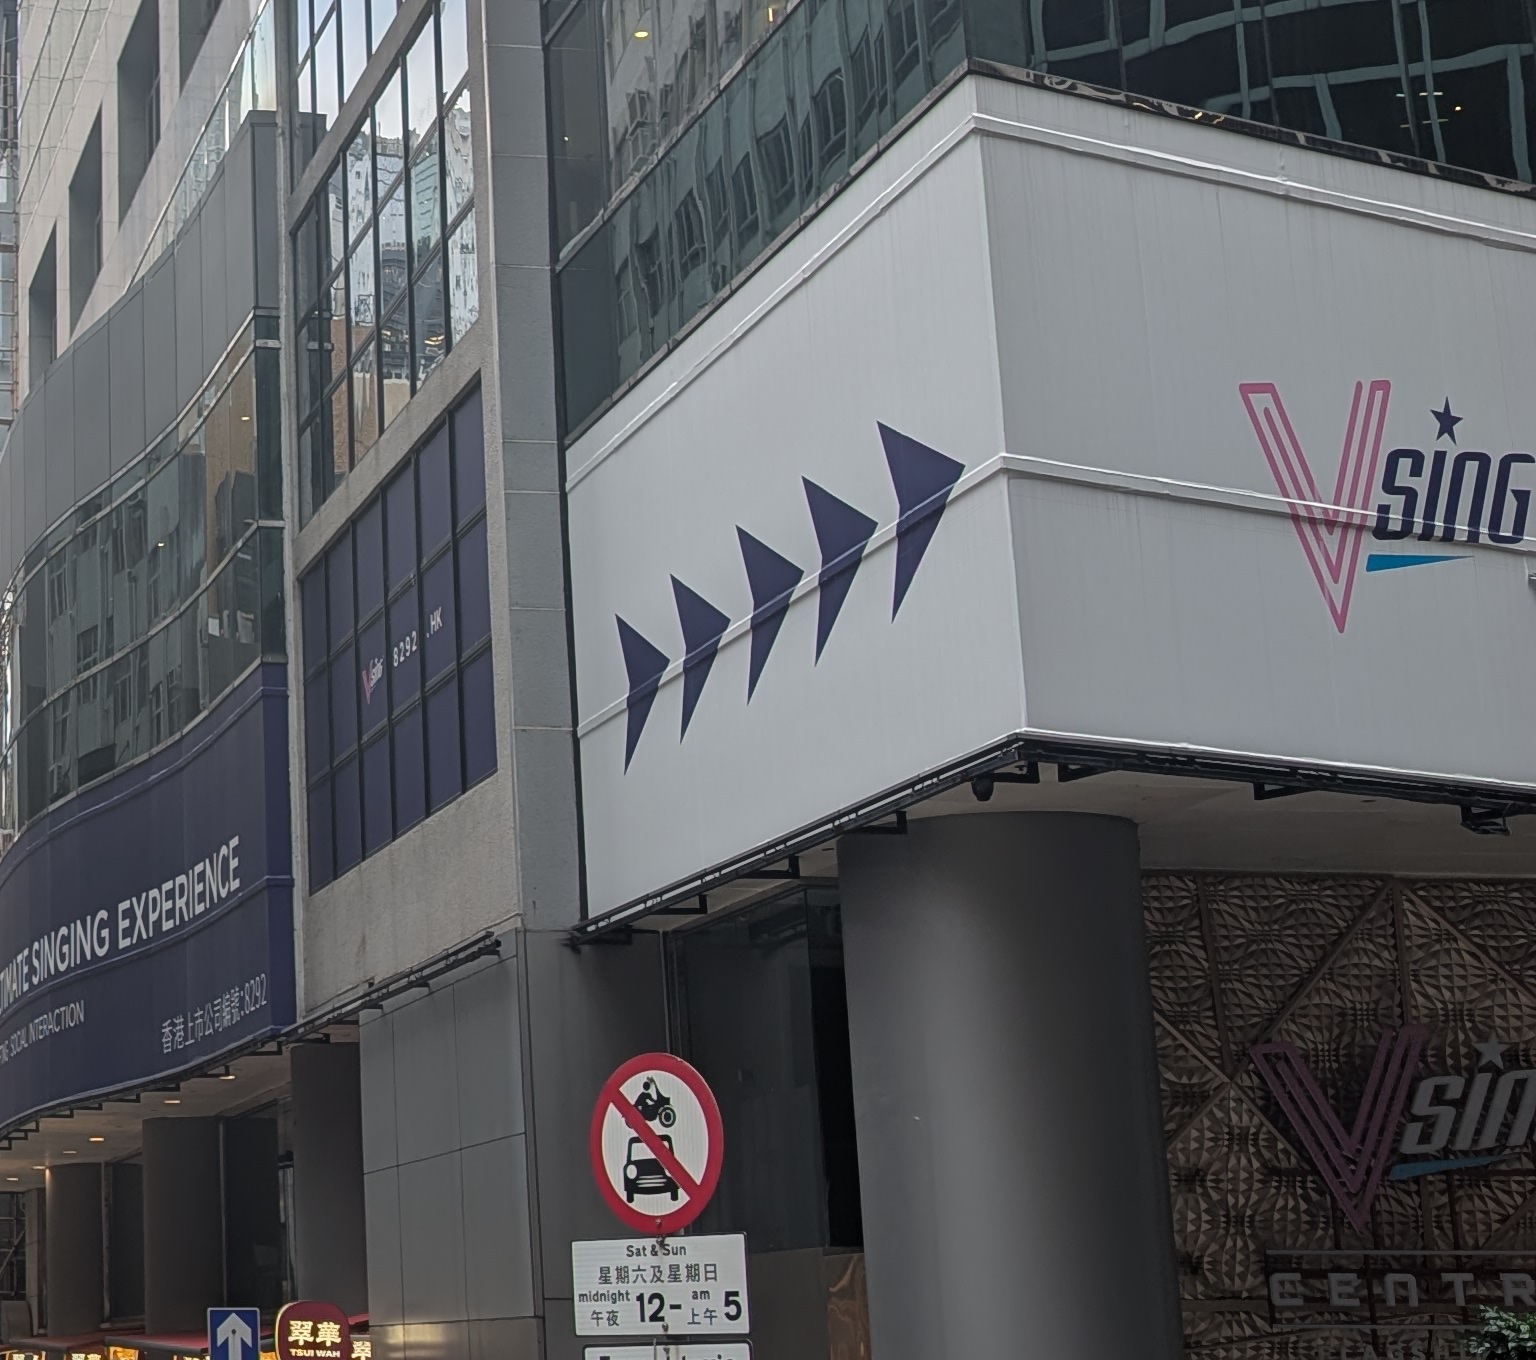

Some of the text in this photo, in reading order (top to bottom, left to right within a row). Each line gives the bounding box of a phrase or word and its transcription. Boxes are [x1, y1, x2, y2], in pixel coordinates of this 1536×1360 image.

[393, 630, 418, 668] 8292
[32, 908, 110, 986] SINGING
[117, 834, 241, 950] EXPERIENCE
[626, 1243, 687, 1257] Sat & Sun
[598, 1262, 718, 1285] 星期六及星期日
[578, 1289, 631, 1304] midnight
[692, 1290, 711, 1300] am
[724, 1291, 742, 1321] 5
[590, 1308, 718, 1327] 午夜 上午
[288, 1320, 342, 1347] 翠華
[289, 1348, 341, 1358] TSUI WAH
